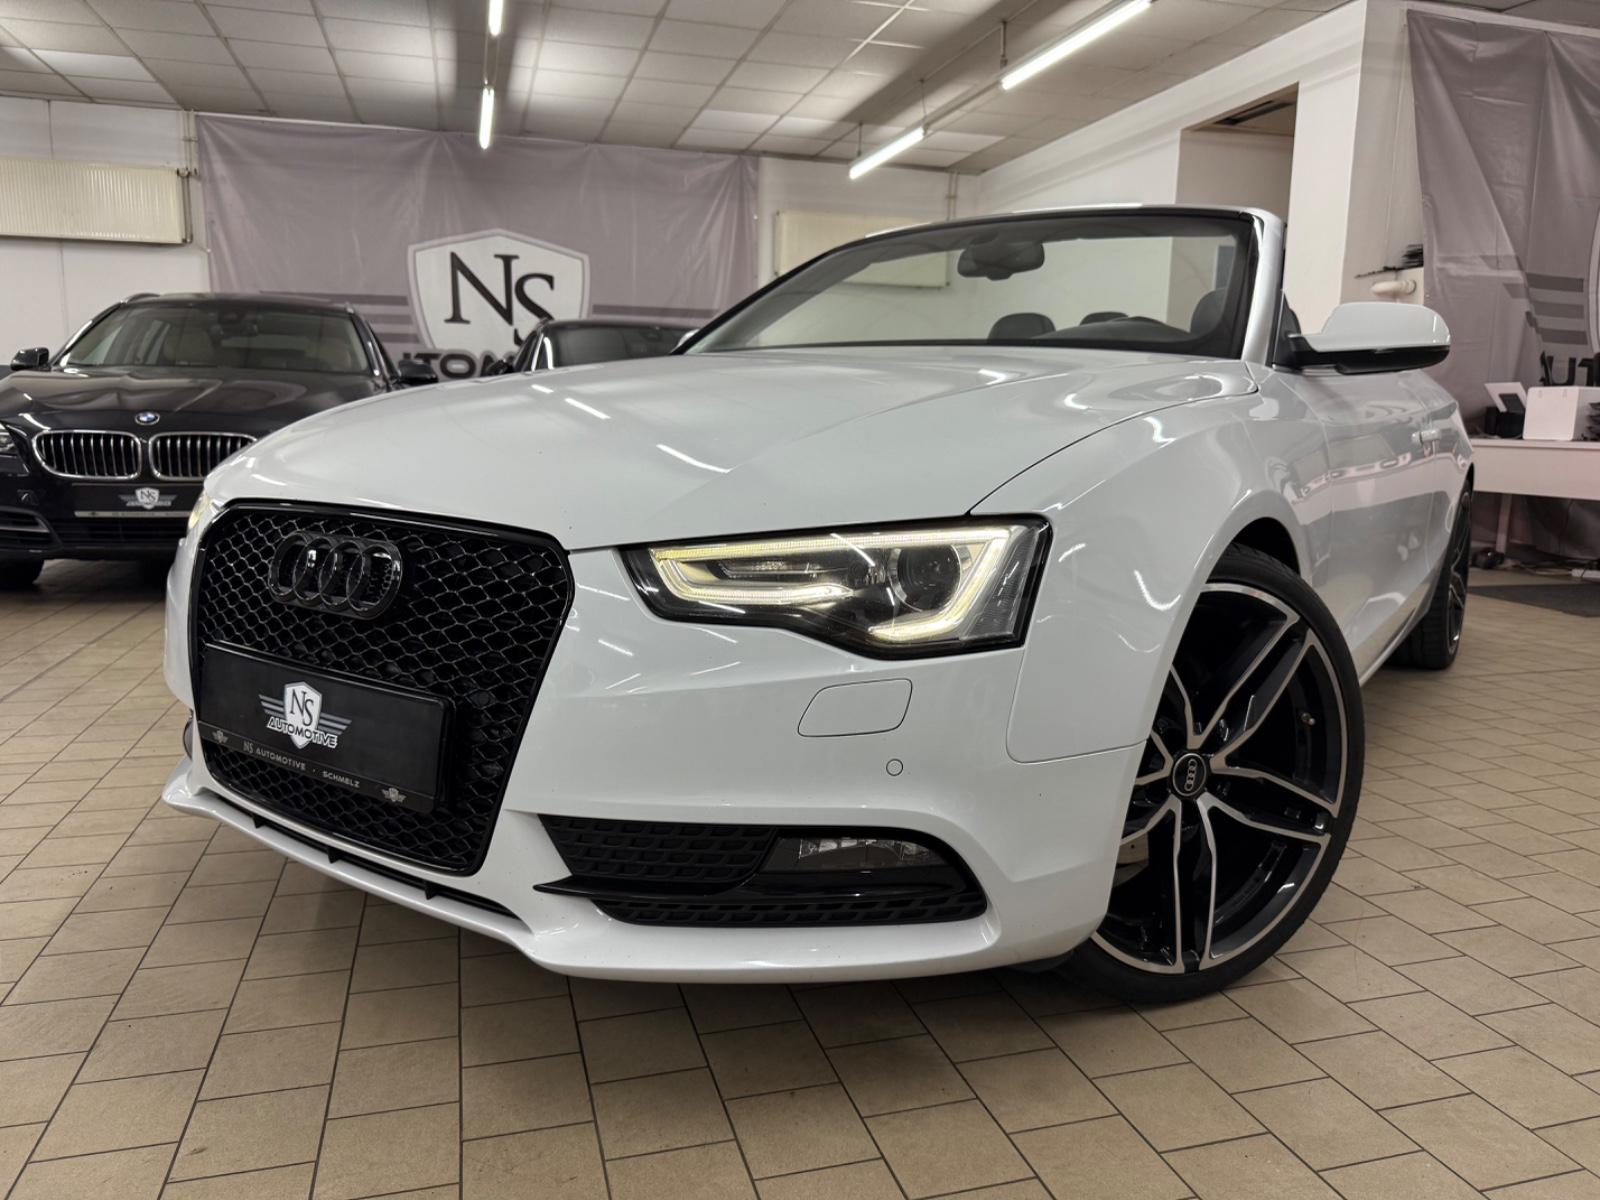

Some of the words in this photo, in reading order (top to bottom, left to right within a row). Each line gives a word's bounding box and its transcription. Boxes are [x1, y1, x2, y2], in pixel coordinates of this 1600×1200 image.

[444, 251, 555, 346] NS
[402, 352, 517, 379] TO
[290, 688, 315, 727] NS
[266, 717, 338, 748] AUTOMOTIVE
[243, 741, 254, 754] NS
[256, 747, 306, 771] AUTOMOTIVE
[322, 771, 360, 789] SCHMELZ
